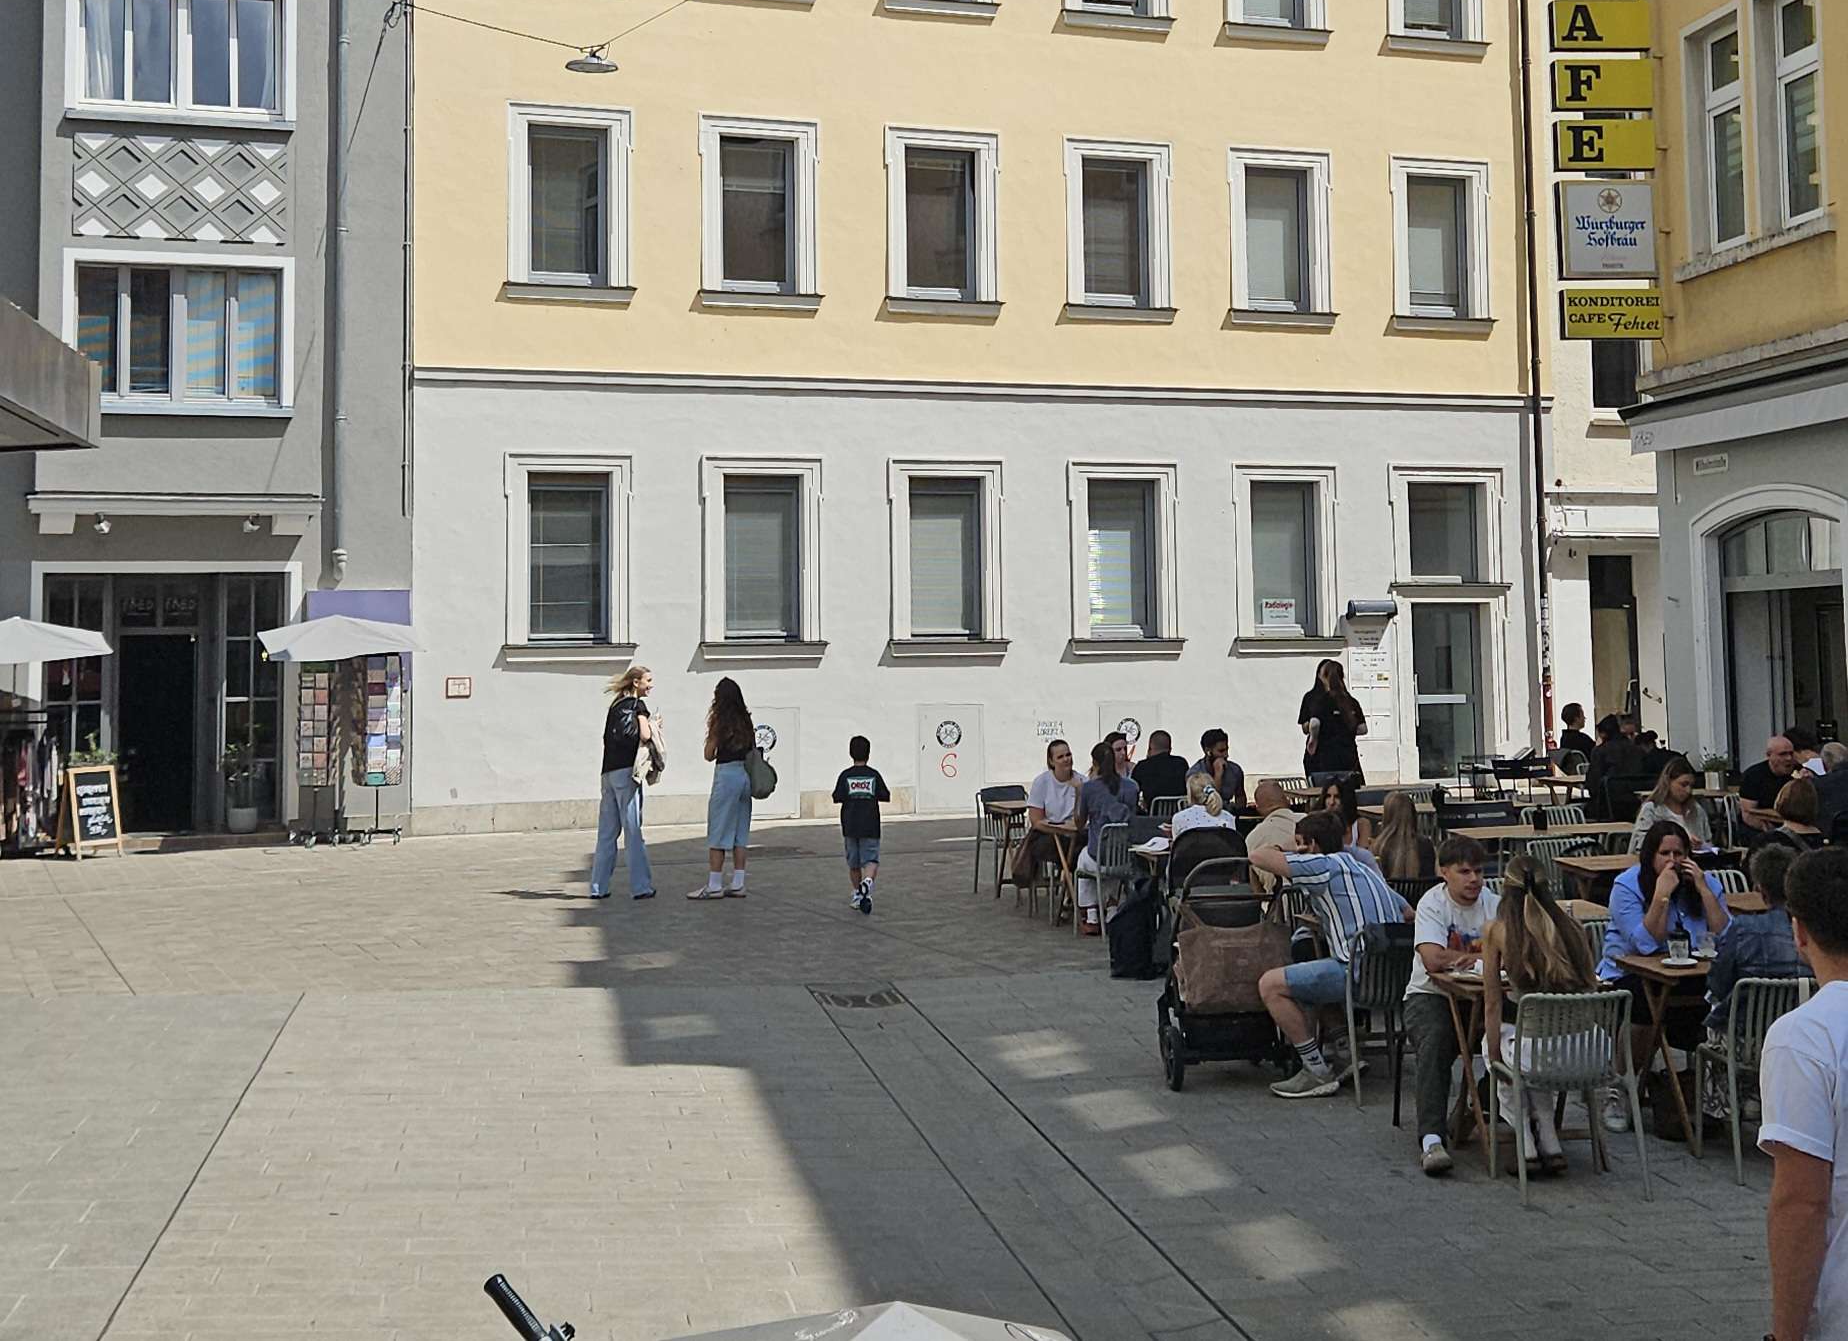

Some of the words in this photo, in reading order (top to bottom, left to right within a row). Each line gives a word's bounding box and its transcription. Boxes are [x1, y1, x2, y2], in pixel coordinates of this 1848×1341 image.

[1568, 296, 1660, 307] KONDITOREI
[1568, 313, 1606, 324] CAFE
[941, 753, 957, 778] 6
